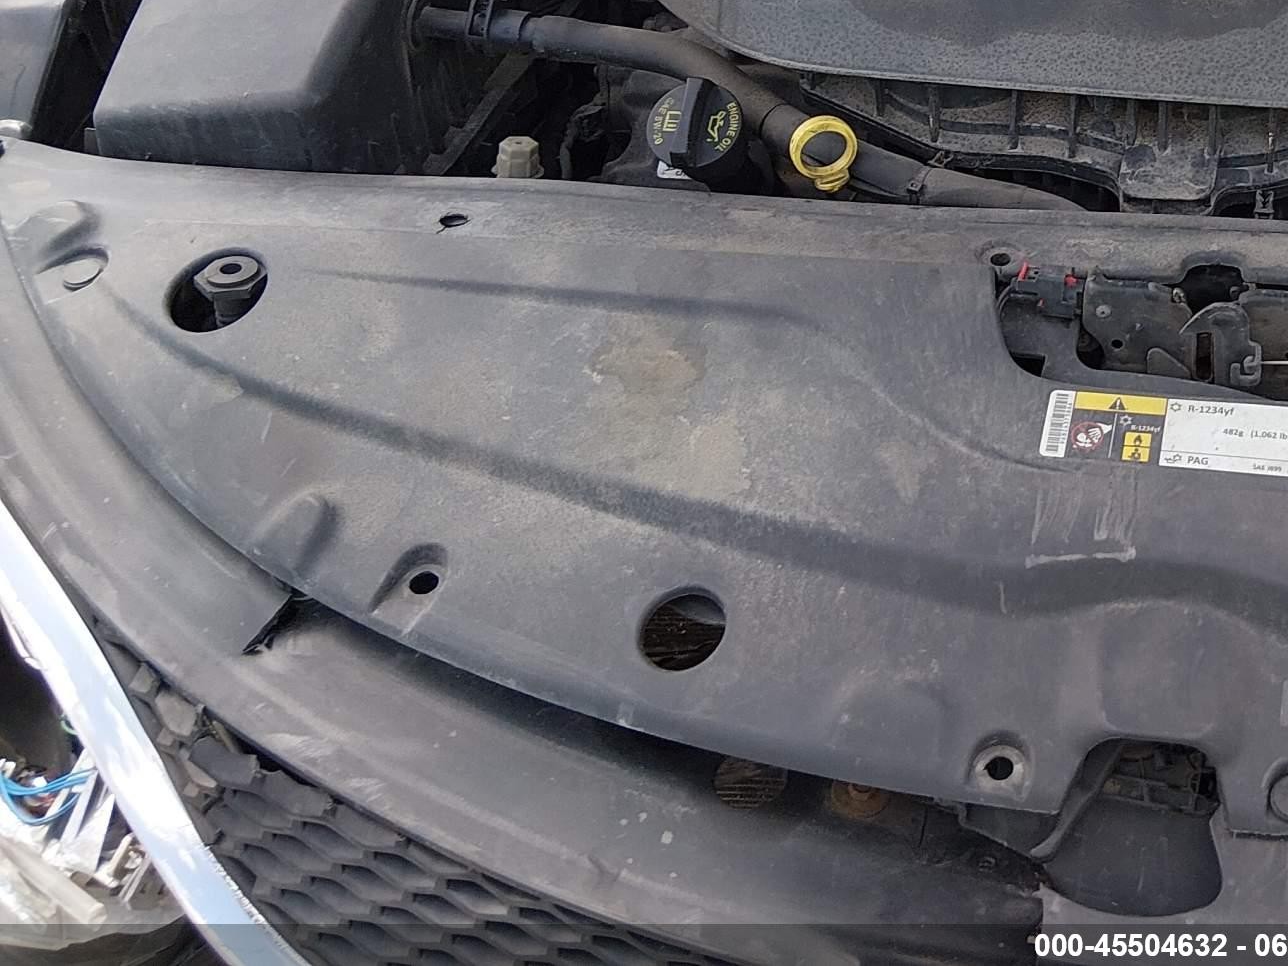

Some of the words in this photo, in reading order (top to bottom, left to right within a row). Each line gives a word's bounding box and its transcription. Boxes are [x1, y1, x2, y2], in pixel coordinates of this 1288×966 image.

[726, 101, 739, 138] ENGINE
[714, 137, 732, 152] OIL
[1187, 405, 1235, 416] R-1234yf
[1223, 428, 1244, 438] 482g
[1250, 429, 1277, 440] (1.062
[1187, 456, 1209, 466] PAG
